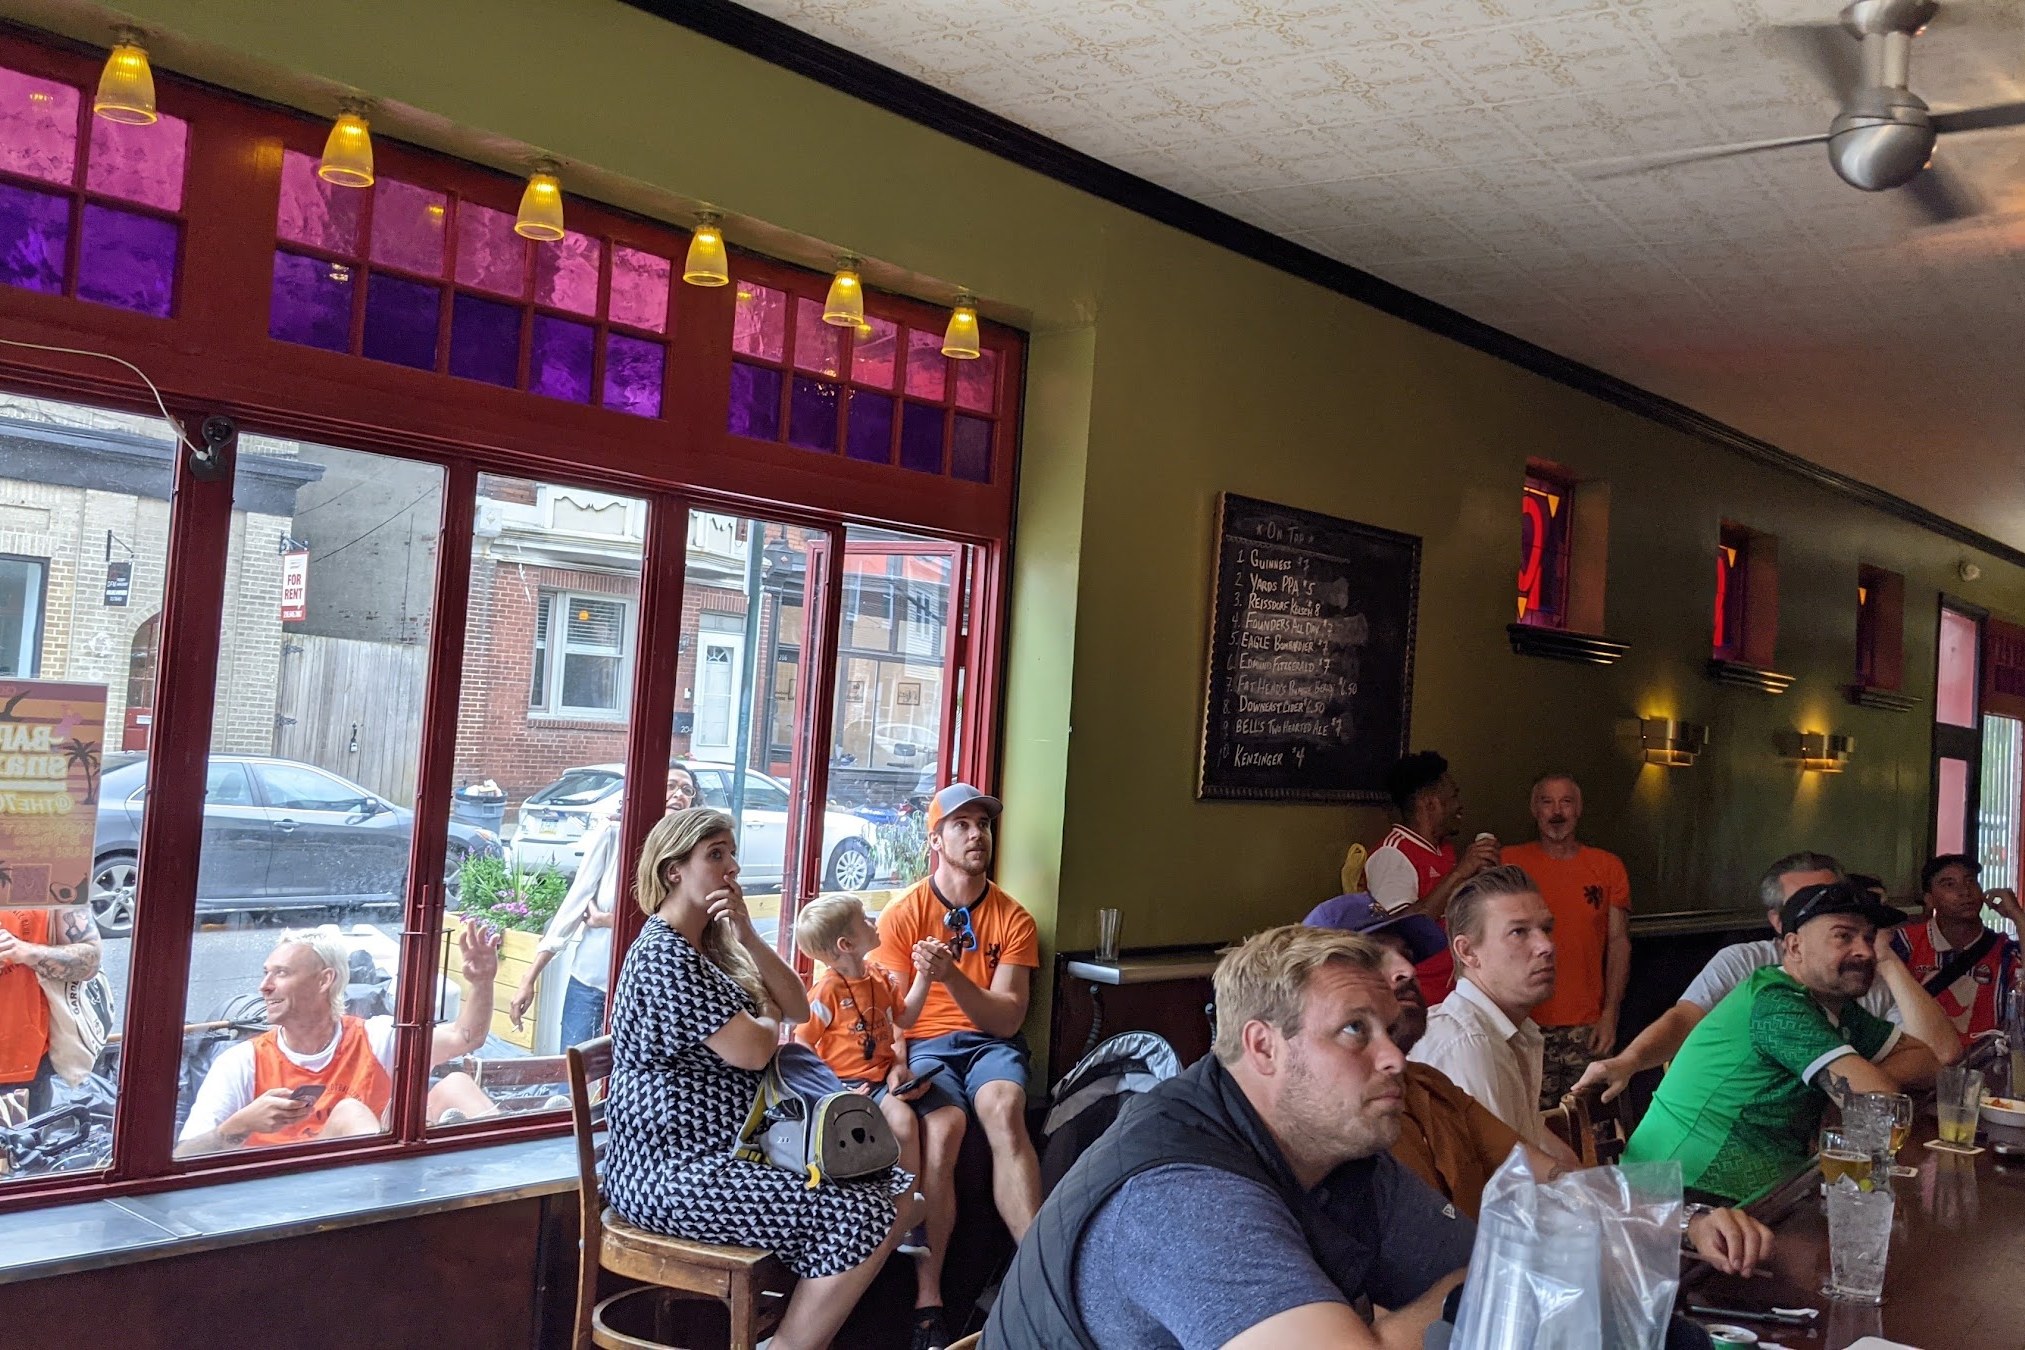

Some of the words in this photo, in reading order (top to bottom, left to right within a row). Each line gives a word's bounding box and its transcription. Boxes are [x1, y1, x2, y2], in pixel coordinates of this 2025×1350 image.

[287, 574, 302, 585] FOR
[1250, 573, 1278, 593] YARDS
[1282, 575, 1299, 597] PPA
[284, 588, 303, 599] RENT
[1245, 611, 1290, 631] FOUNDERS
[1241, 632, 1270, 649] EAGLE
[1234, 743, 1284, 767] KENZINGER
